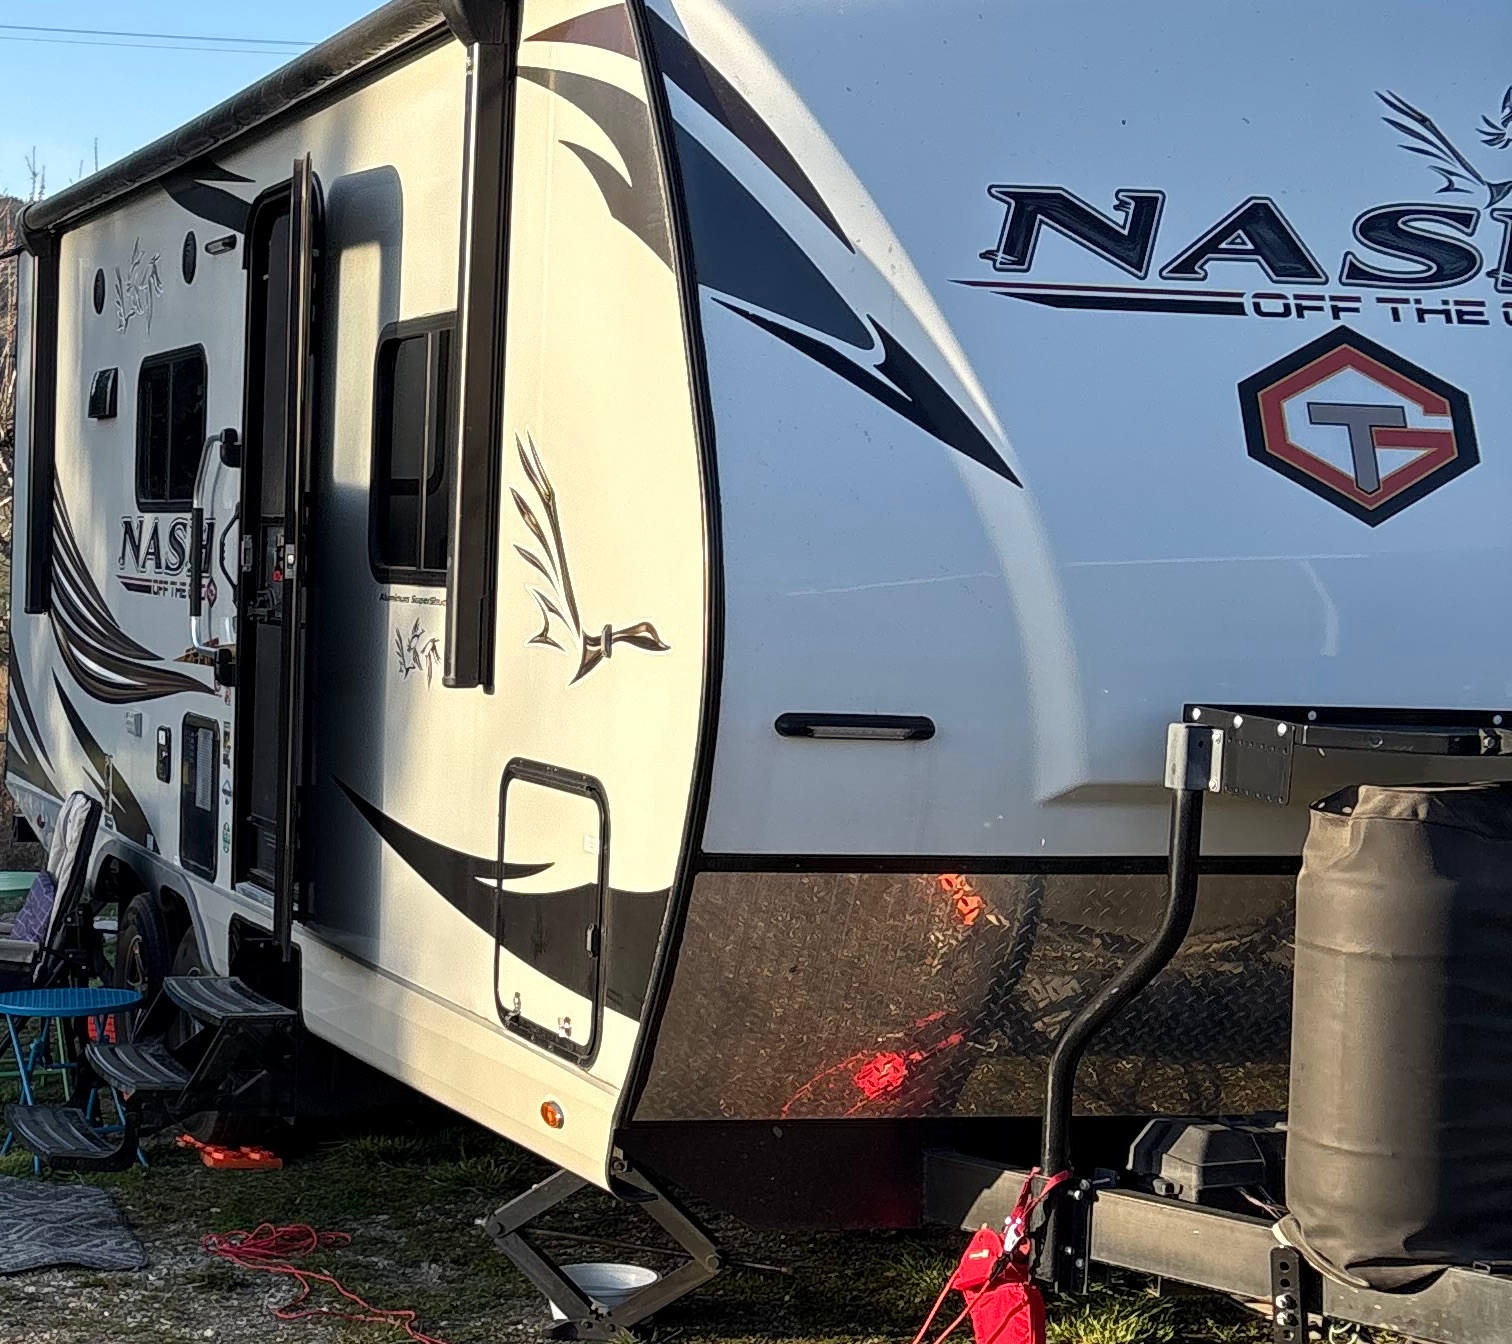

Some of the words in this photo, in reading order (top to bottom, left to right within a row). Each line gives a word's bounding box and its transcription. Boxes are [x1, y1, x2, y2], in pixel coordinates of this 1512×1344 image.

[979, 184, 1512, 295] NAS
[1251, 292, 1362, 321] OFF
[1375, 297, 1491, 326] THE
